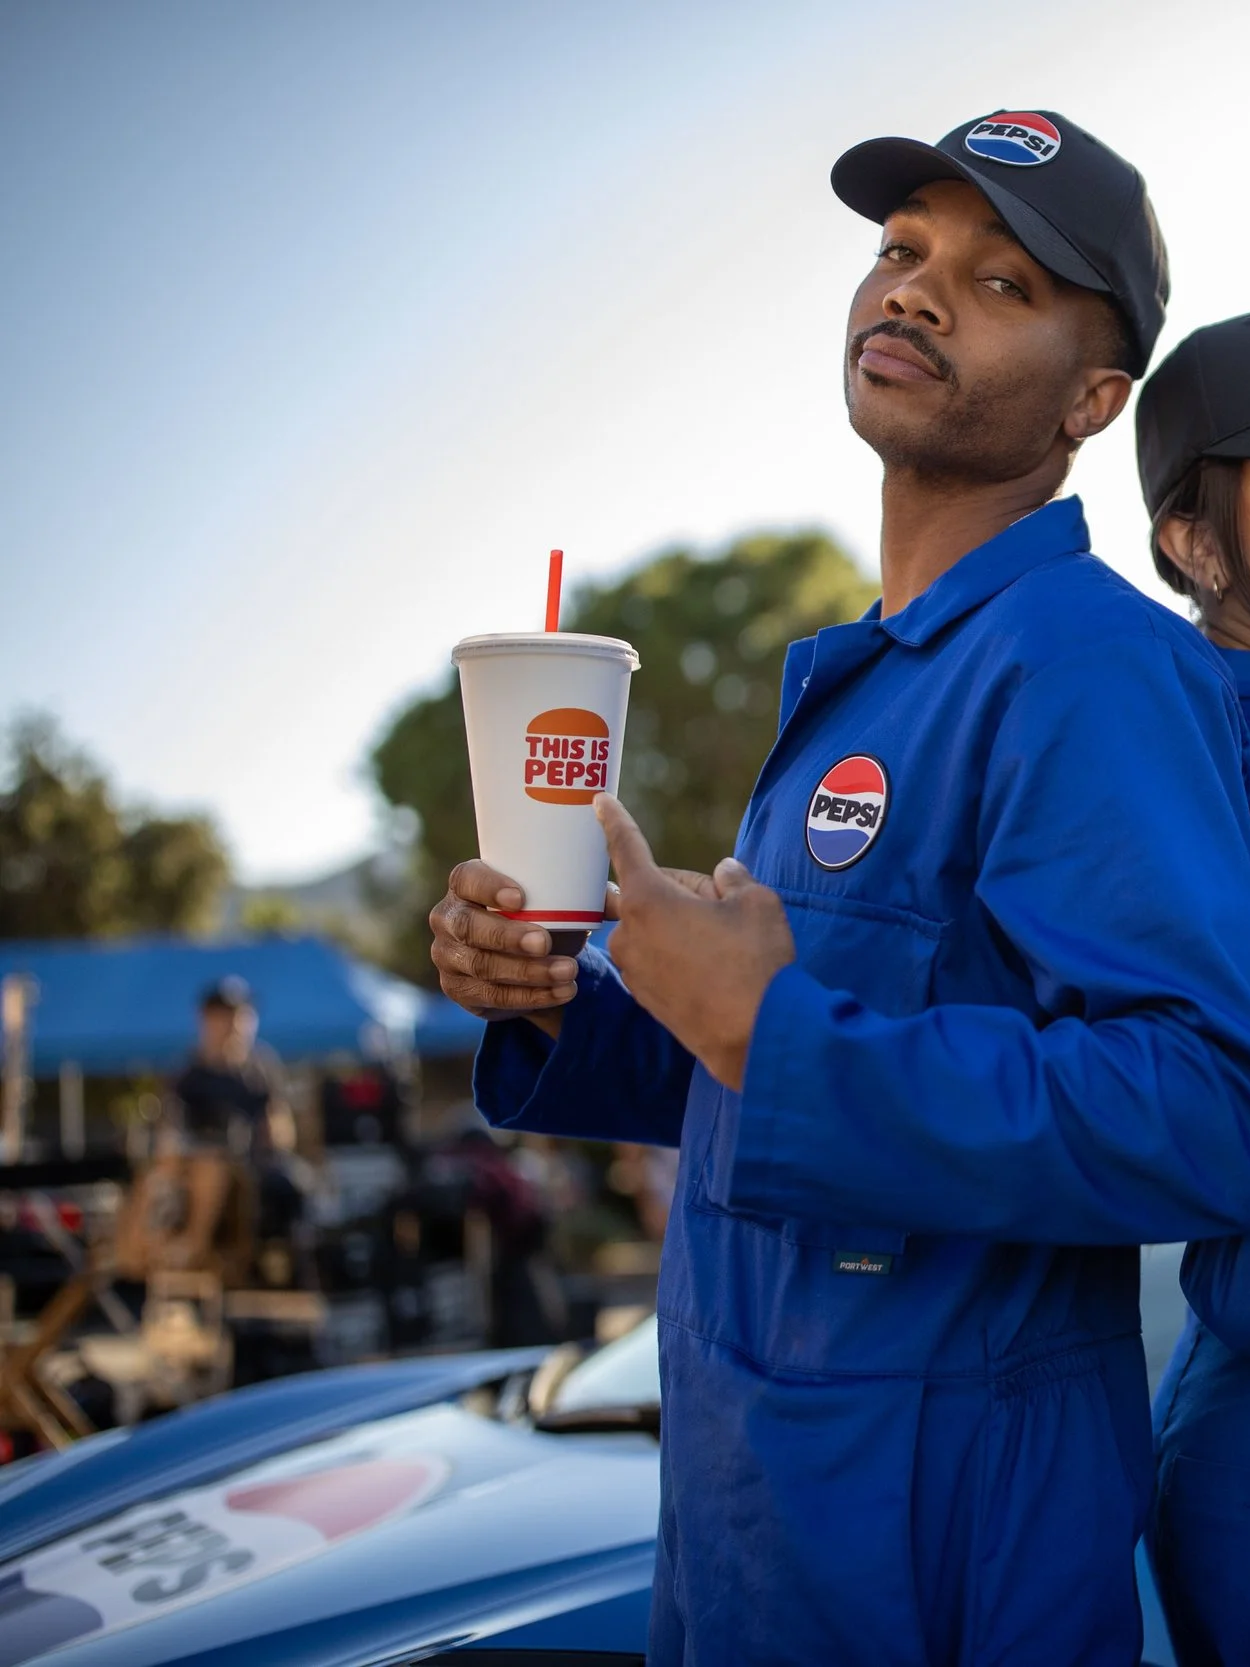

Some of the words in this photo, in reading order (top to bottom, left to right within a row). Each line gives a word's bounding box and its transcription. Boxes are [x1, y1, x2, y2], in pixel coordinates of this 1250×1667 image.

[973, 123, 1055, 157] PEPSI
[525, 736, 586, 760] THIS
[591, 739, 610, 761] IS
[525, 759, 607, 788] PEPSI
[811, 794, 881, 829] PEPSI
[840, 1261, 883, 1272] PORTWEST
[80, 1510, 256, 1606] PEPS
